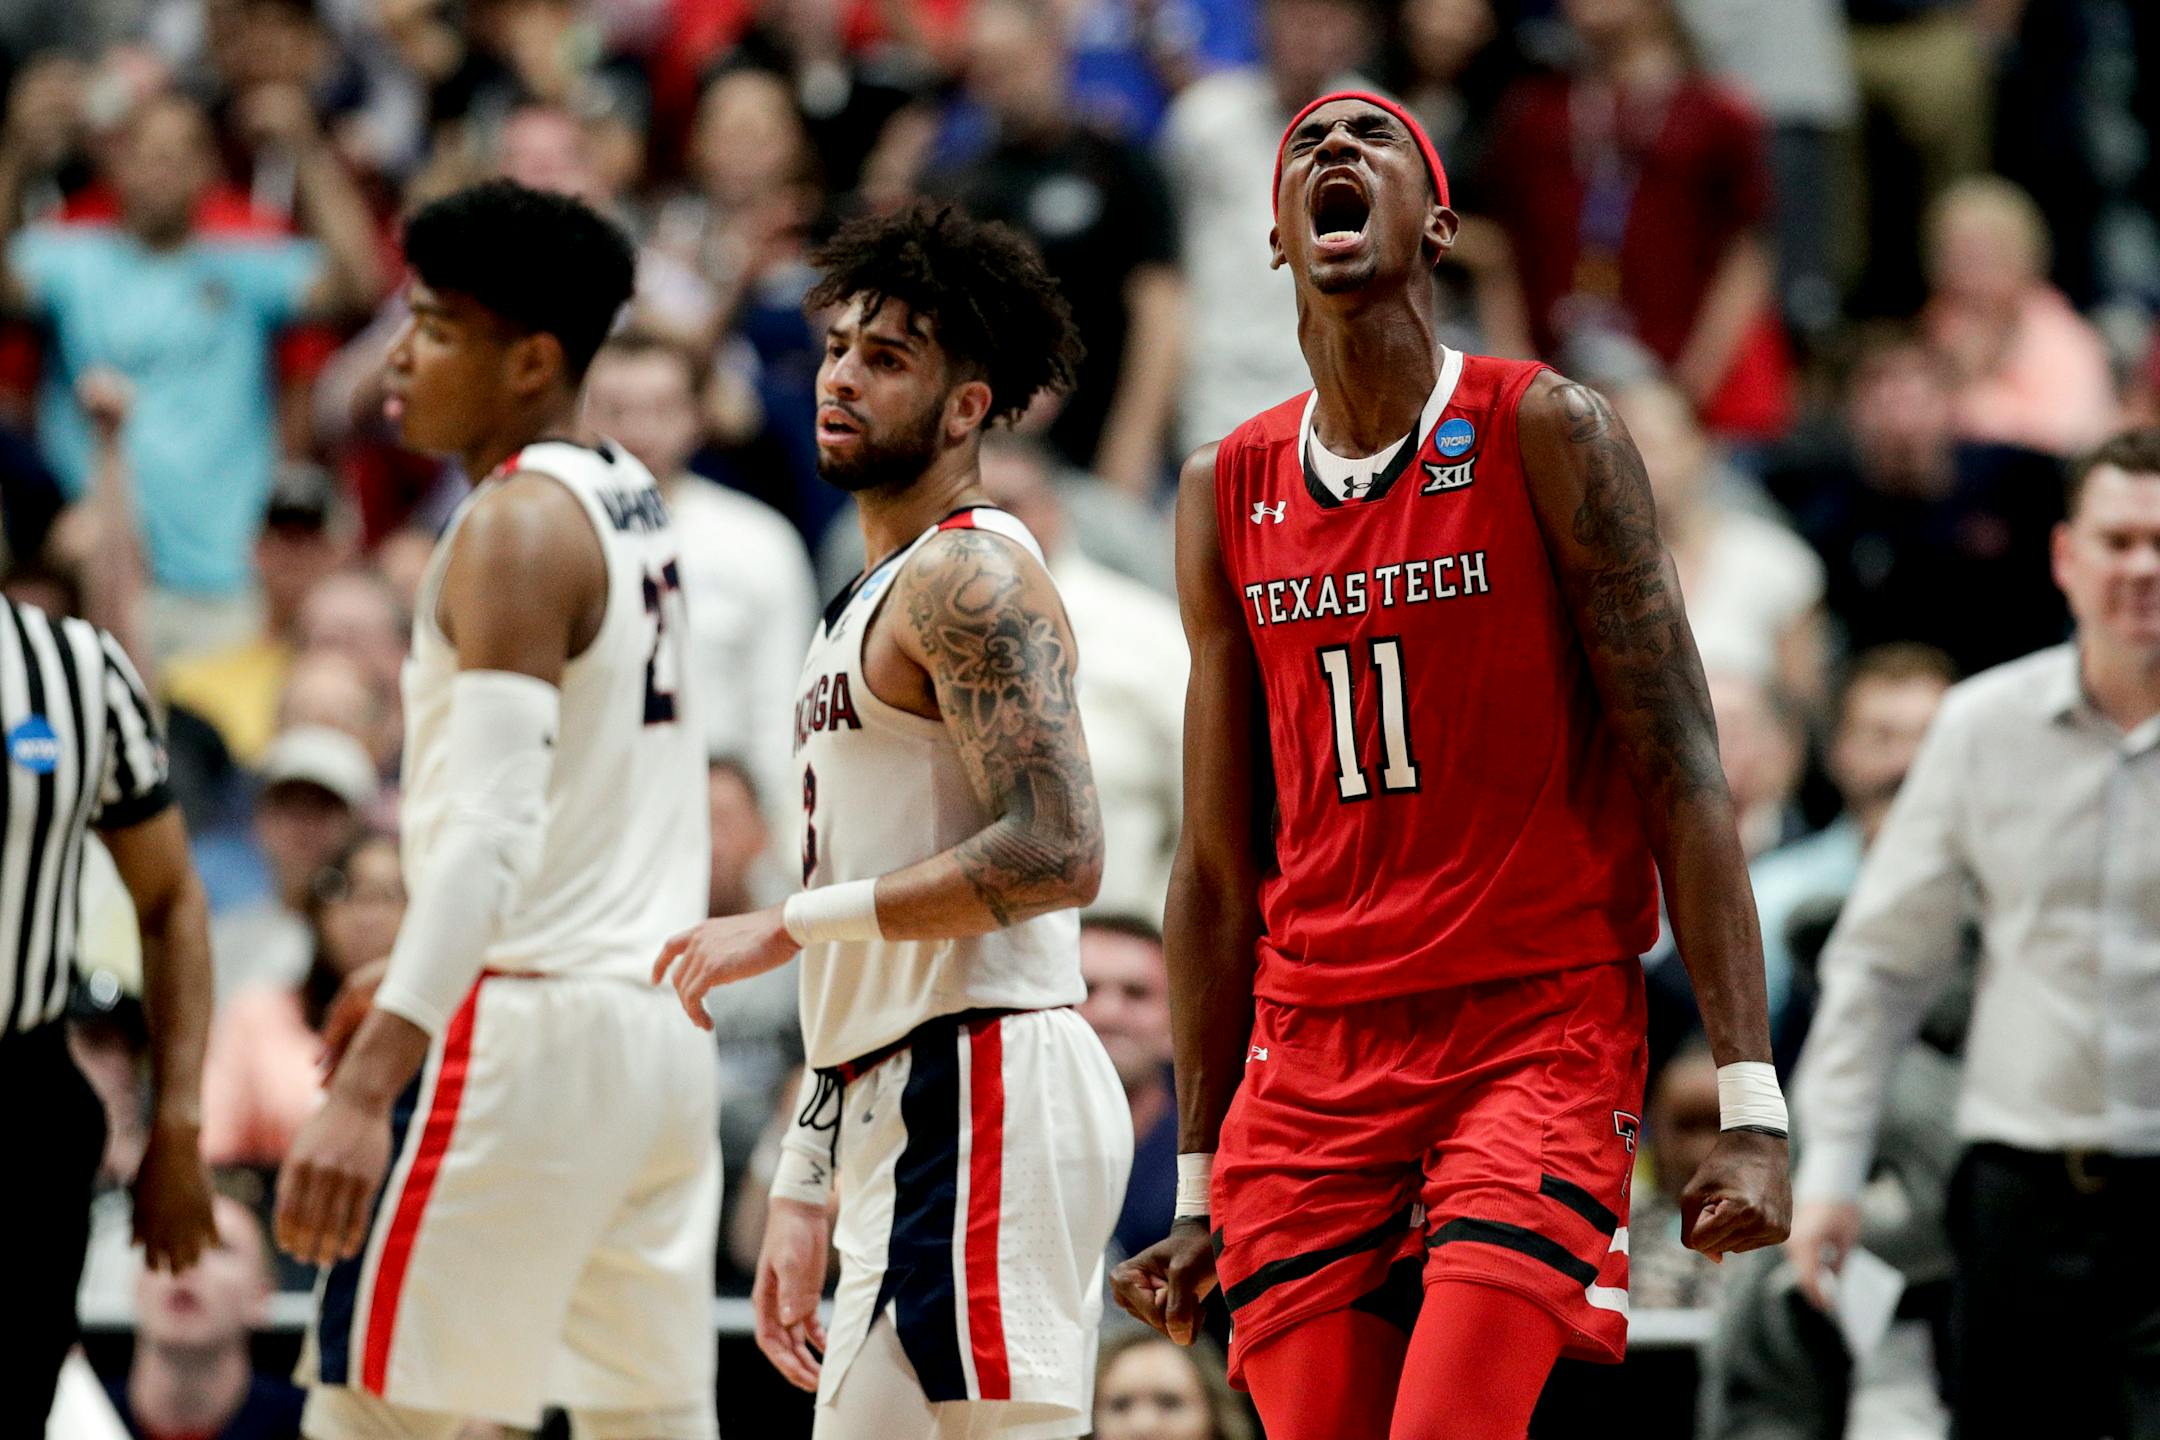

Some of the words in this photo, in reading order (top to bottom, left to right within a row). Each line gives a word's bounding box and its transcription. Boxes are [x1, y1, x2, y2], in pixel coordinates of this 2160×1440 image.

[1440, 434, 1472, 447] NCAA
[1423, 456, 1476, 492] XII
[1245, 572, 1367, 626] TEXAS
[1375, 551, 1489, 607] TECH
[1319, 638, 1420, 800] 11
